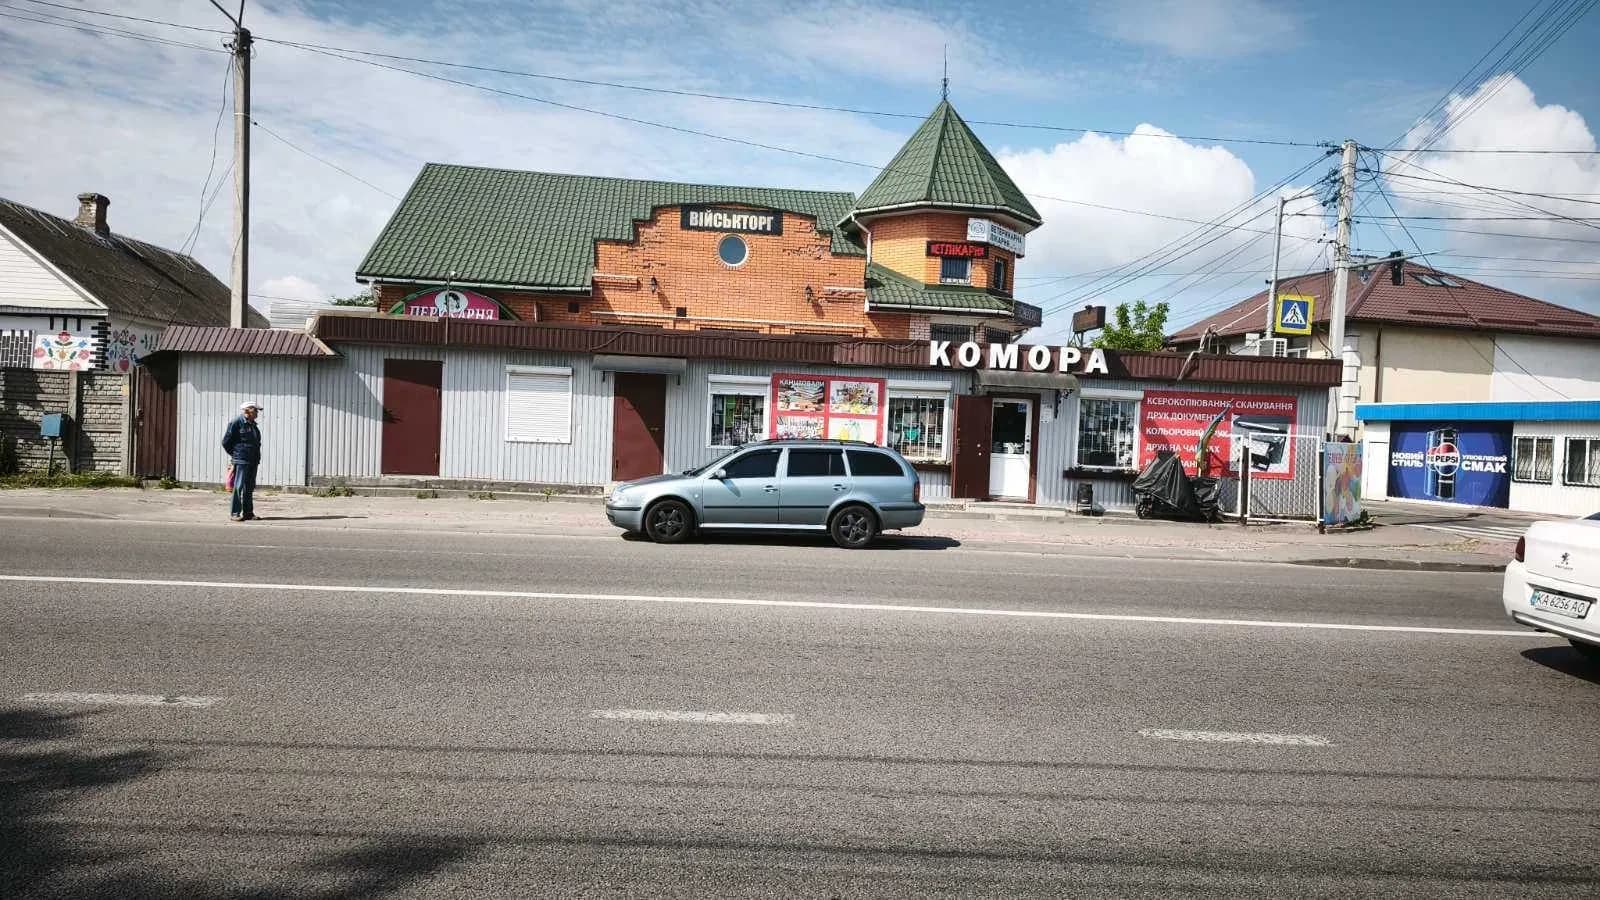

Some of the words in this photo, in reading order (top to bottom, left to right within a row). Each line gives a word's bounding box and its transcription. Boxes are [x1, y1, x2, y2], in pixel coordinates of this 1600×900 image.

[689, 208, 774, 231] ВІЙСЬКТОРГ
[928, 340, 1109, 374] КОМОРА
[1235, 400, 1293, 411] СКАНУВАННЯ
[1146, 411, 1169, 420] ДРУК
[1145, 443, 1169, 452] ДРУК
[1170, 444, 1181, 452] НА
[1392, 451, 1425, 461] НОВИЙ
[1435, 455, 1459, 464] PEPSI
[1391, 459, 1424, 468] СТИЛЬ
[1461, 460, 1507, 474] СМАК
[1550, 596, 1570, 610] 6256
